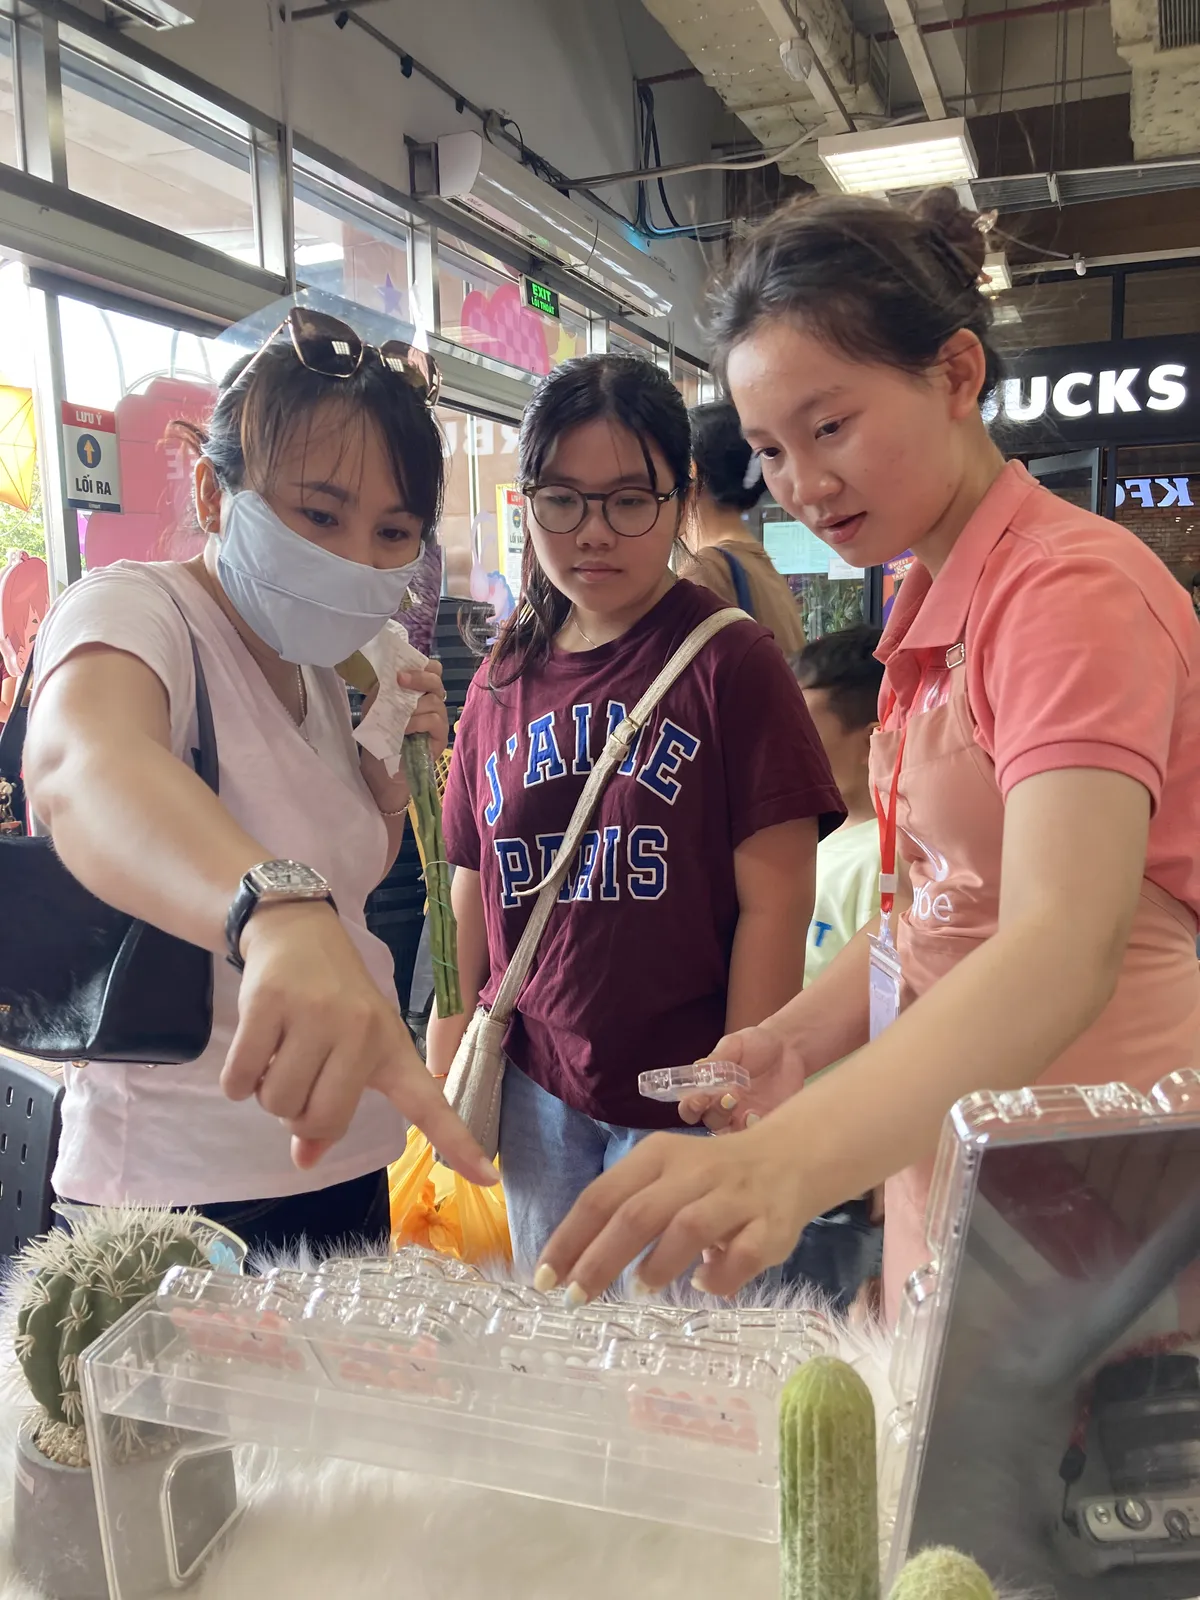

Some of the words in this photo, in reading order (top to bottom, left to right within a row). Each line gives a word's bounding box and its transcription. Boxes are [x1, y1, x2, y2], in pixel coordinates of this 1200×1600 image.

[531, 282, 552, 302] EXIT
[75, 410, 95, 424] LƯU
[95, 412, 103, 426] Ý
[75, 474, 93, 494] LỐI
[96, 481, 112, 496] RA
[493, 825, 668, 909] PARIS
